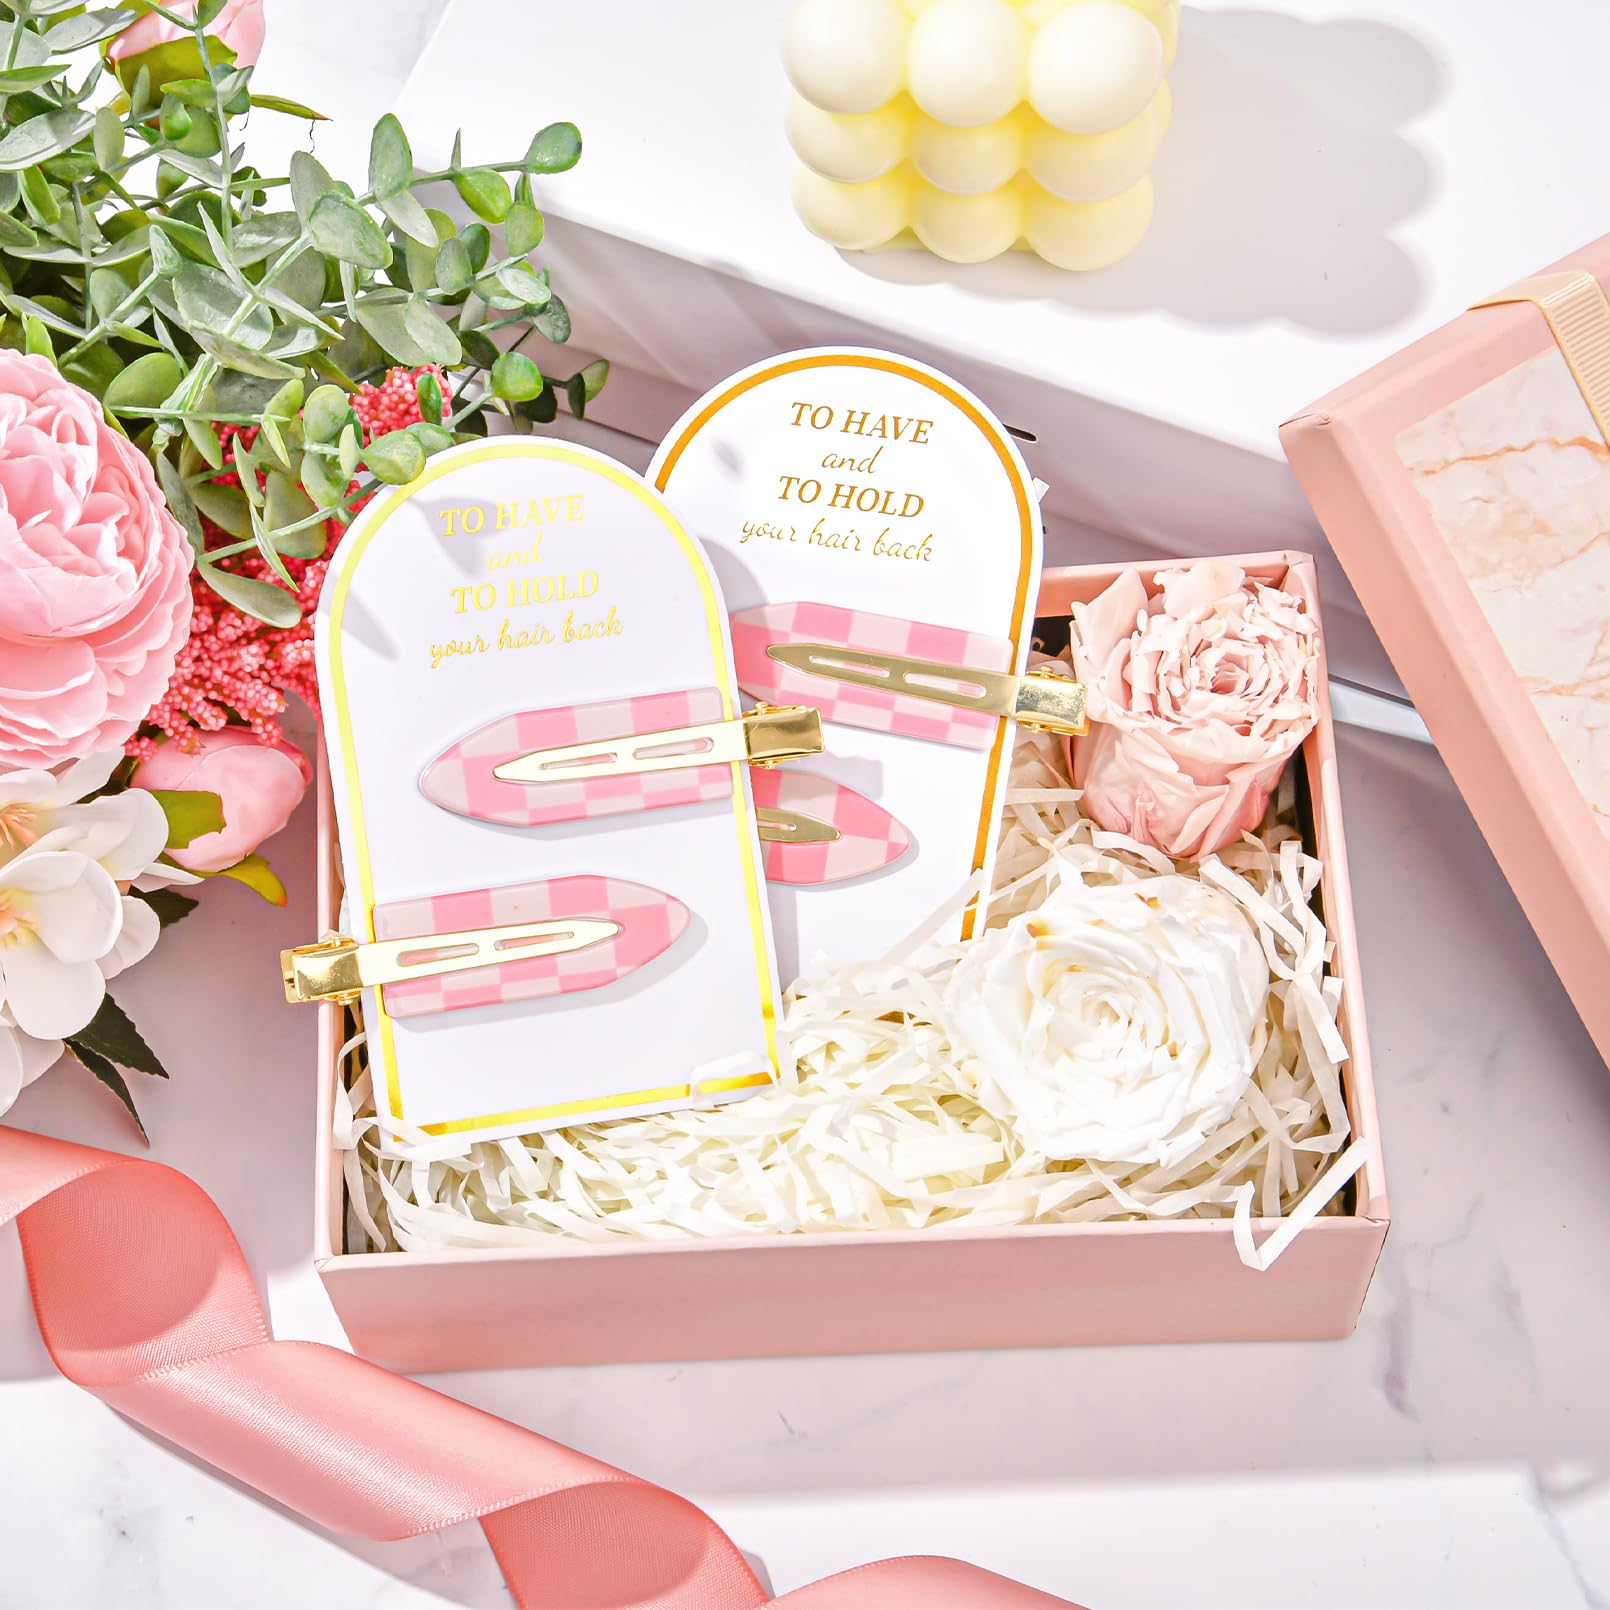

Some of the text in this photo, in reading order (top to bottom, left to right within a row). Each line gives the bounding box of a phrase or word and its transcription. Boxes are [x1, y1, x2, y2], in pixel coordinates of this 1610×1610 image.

[791, 402, 934, 444] TO HAVE
[821, 445, 884, 474] and
[439, 494, 585, 536] TO HAVE
[778, 475, 924, 518] TO HOLD
[486, 531, 543, 571] and
[739, 518, 934, 562] your hair back
[450, 571, 600, 614] TO HOLD
[429, 605, 624, 669] your hair back
